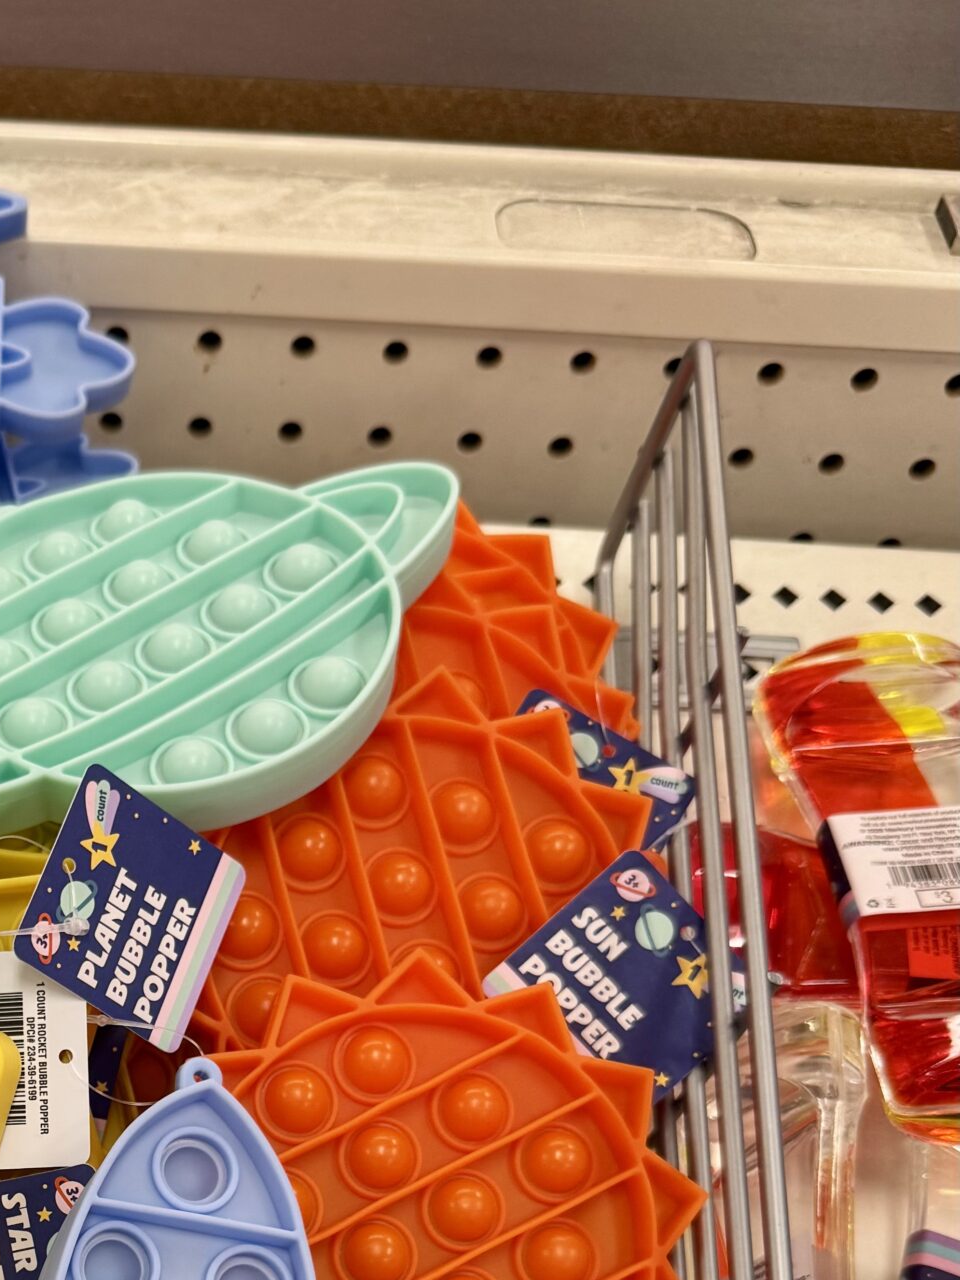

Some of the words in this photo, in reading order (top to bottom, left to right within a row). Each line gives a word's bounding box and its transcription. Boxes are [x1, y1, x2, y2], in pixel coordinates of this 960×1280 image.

[623, 770, 633, 787] 1
[650, 775, 680, 791] count
[96, 789, 108, 822] count
[91, 841, 108, 854] 1
[625, 875, 639, 889] 3+
[77, 866, 138, 989] PLANET
[105, 884, 167, 1007] BUBBLE
[571, 906, 629, 963] SUN
[132, 897, 197, 1024] POPPER
[544, 929, 644, 1032] BUBBLE
[36, 989, 46, 1021] COUNT
[37, 1023, 47, 1059] ROCKET
[27, 1046, 37, 1101] 234-39-6199
[38, 1061, 48, 1096] BUBBLE
[39, 1099, 49, 1135] POPPER
[1, 1193, 38, 1274] STAR
